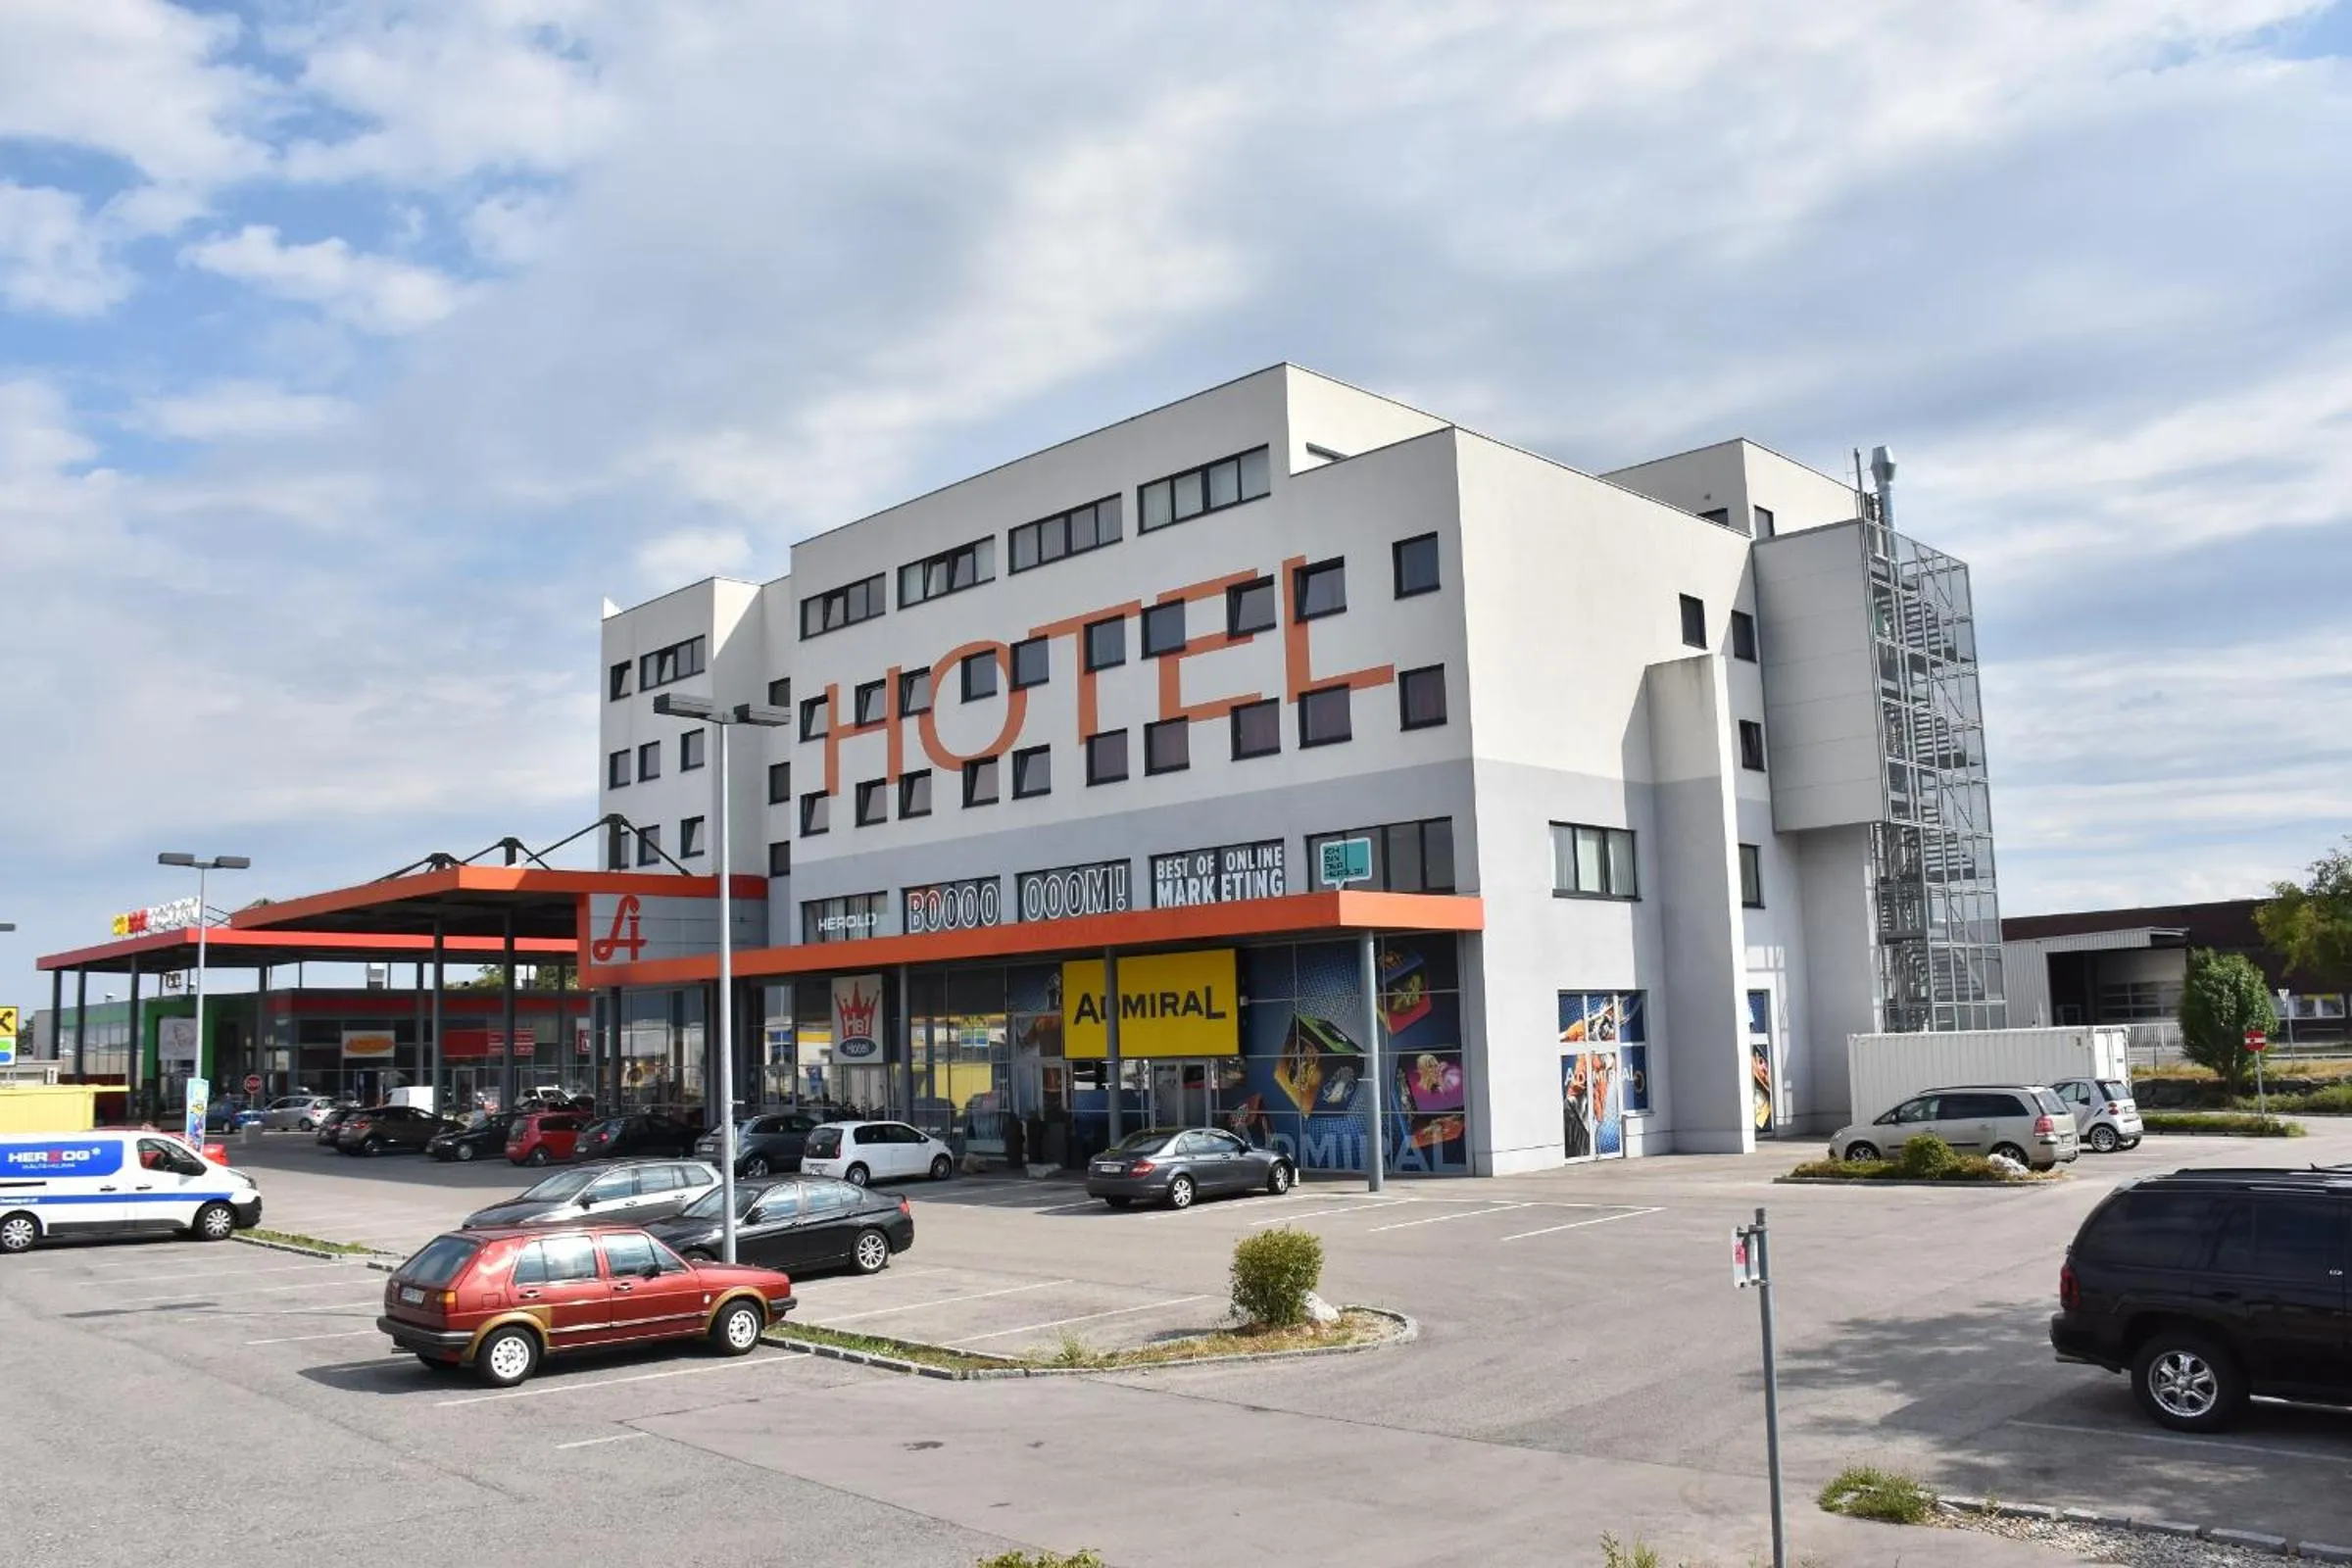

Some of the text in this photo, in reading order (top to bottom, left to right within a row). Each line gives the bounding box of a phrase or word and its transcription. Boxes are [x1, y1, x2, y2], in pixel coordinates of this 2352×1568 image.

[824, 555, 1394, 796] HOTEL
[1156, 846, 1283, 879] BEST OF ONLINE
[907, 865, 1125, 934] BOOOO OOOM!
[817, 912, 877, 932] HEROLD
[8, 1150, 90, 1163] HERZOG
